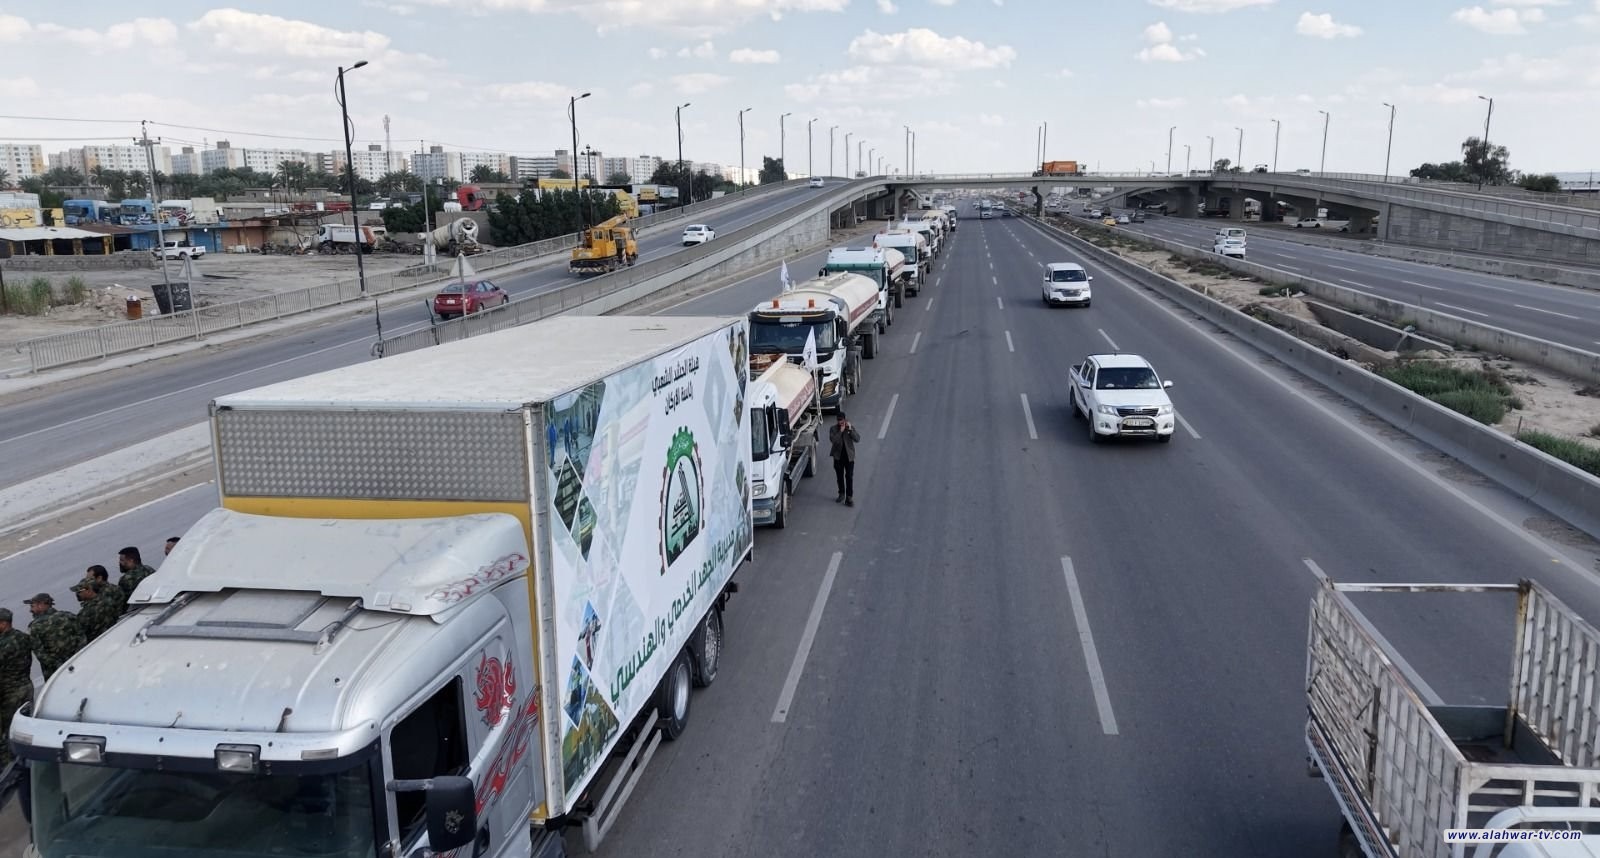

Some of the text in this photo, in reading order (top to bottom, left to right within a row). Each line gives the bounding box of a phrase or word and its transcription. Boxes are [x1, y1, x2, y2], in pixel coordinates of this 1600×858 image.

[651, 366, 673, 398] الشعبي
[673, 359, 688, 381] الحشد
[610, 529, 735, 709] مديرية الجهد الخدمي والهندسي
